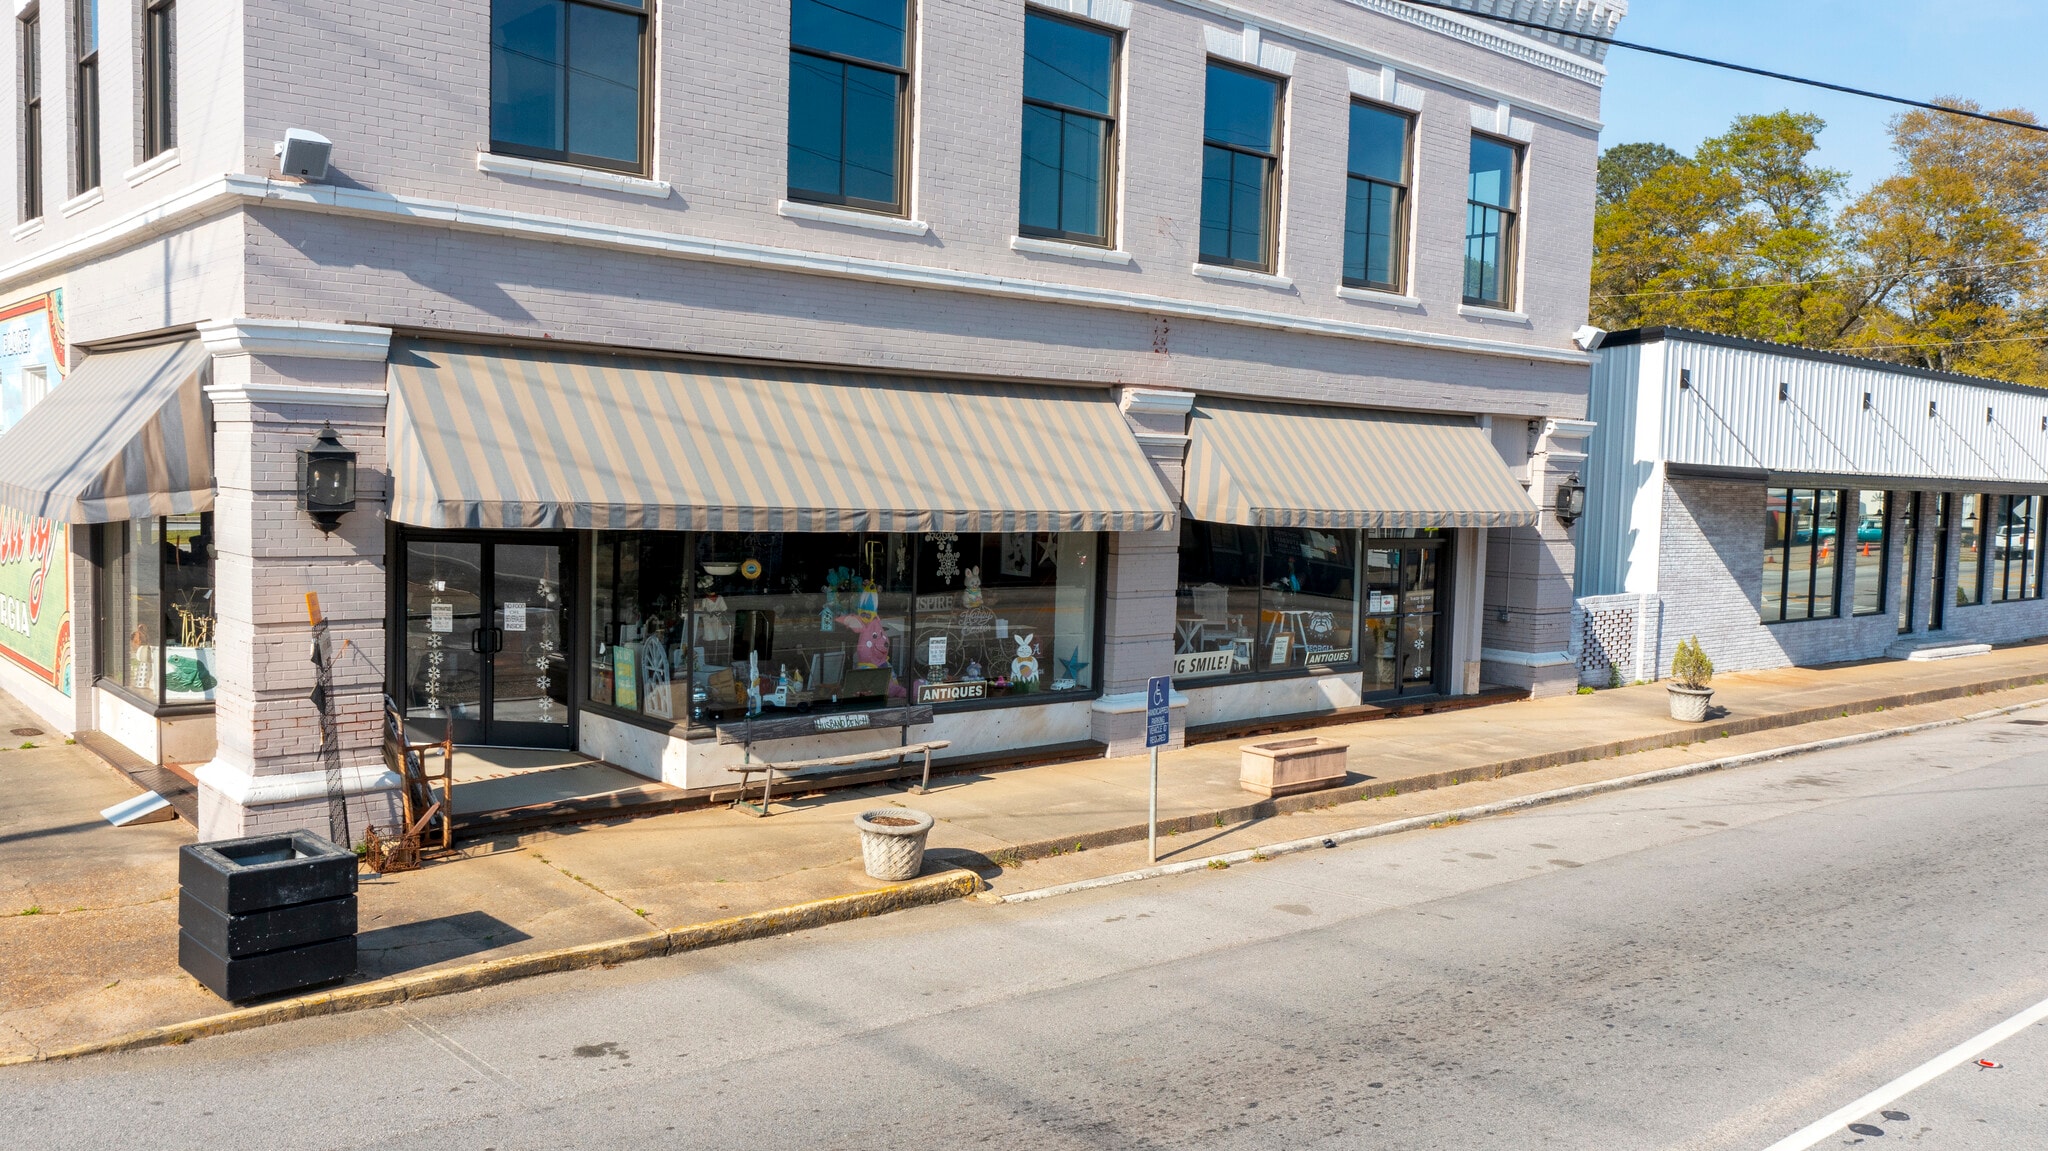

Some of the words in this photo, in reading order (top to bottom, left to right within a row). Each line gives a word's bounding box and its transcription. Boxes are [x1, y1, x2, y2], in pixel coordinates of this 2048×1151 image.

[904, 595, 953, 612] ISPIRE
[1189, 655, 1229, 673] SMILE!
[1308, 651, 1350, 664] ANTIQUES
[922, 684, 984, 701] ANTIQUES
[1151, 716, 1166, 725] PARKING
